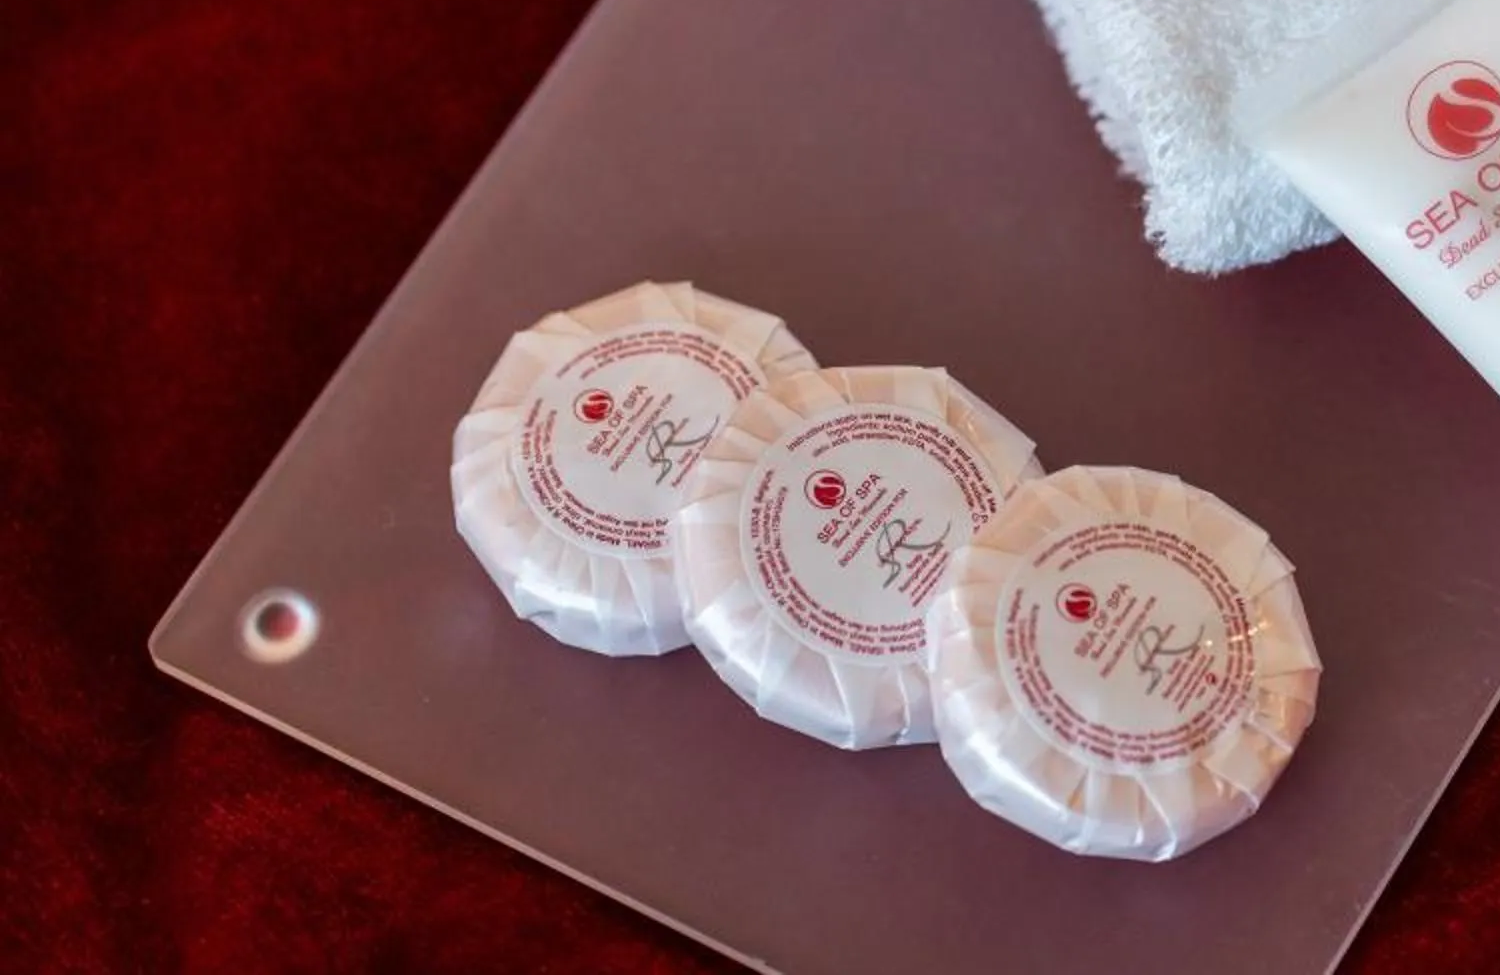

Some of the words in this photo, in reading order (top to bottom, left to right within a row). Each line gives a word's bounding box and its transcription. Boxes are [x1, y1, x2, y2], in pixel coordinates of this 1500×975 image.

[1405, 190, 1478, 250] SEA
[1439, 218, 1492, 269] Dead
[587, 429, 612, 455] SEA
[608, 410, 625, 427] OF
[623, 384, 648, 409] SPA
[817, 518, 841, 545] SEA
[839, 497, 858, 519] OF
[855, 472, 882, 500] SPA
[1074, 630, 1097, 658] SEA
[1093, 608, 1110, 630] OF
[1105, 582, 1131, 610] SPA
